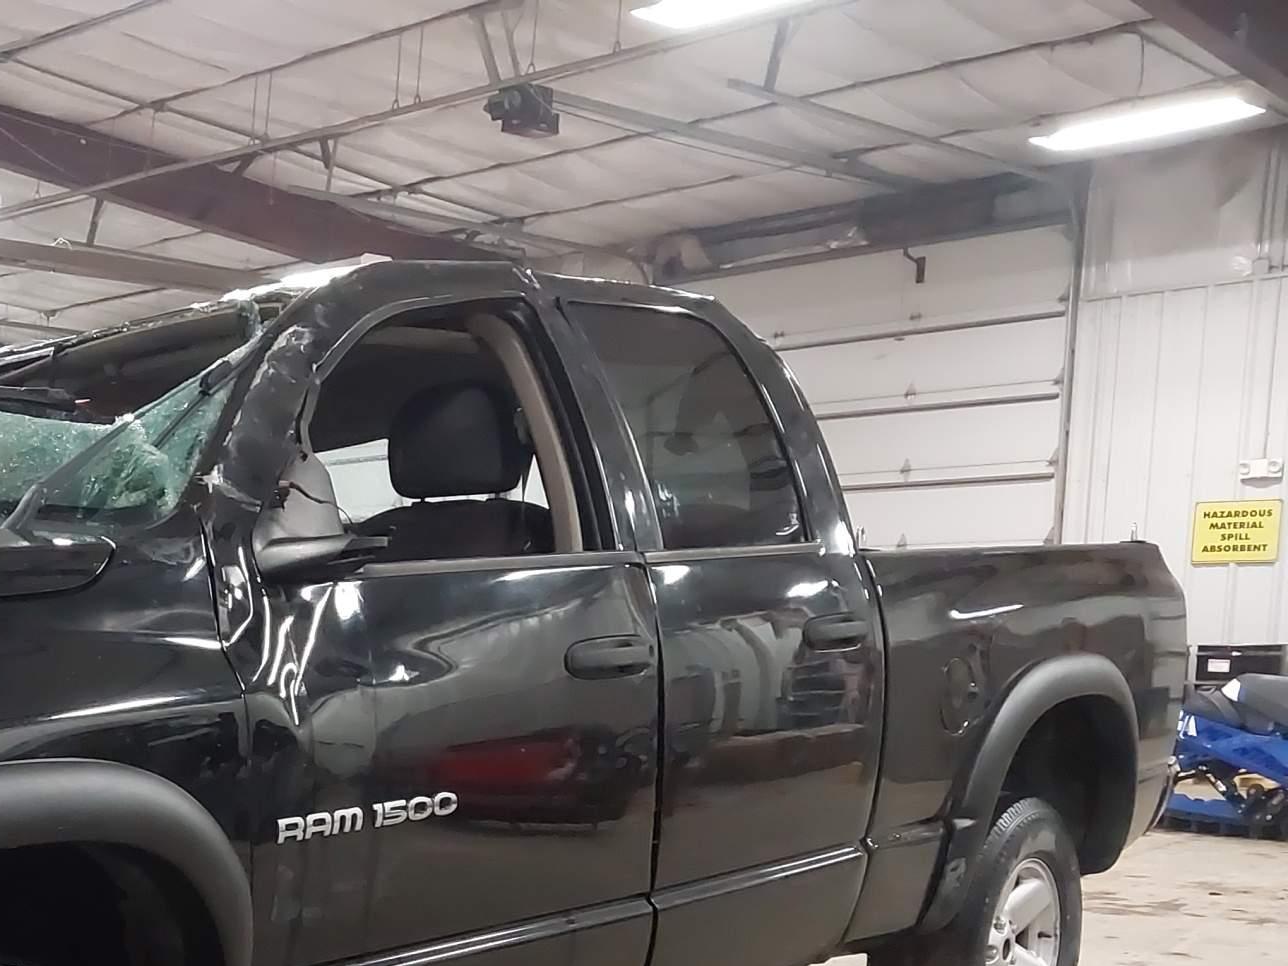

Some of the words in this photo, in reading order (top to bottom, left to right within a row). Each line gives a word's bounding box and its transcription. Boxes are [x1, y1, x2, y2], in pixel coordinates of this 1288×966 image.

[1203, 509, 1273, 519] HAZARDOUS
[1209, 521, 1265, 530] MATERIAL
[1220, 533, 1251, 541] SPILL
[1201, 544, 1268, 553] ABSORBENT
[276, 806, 363, 844] RAM
[372, 791, 458, 828] 1500
